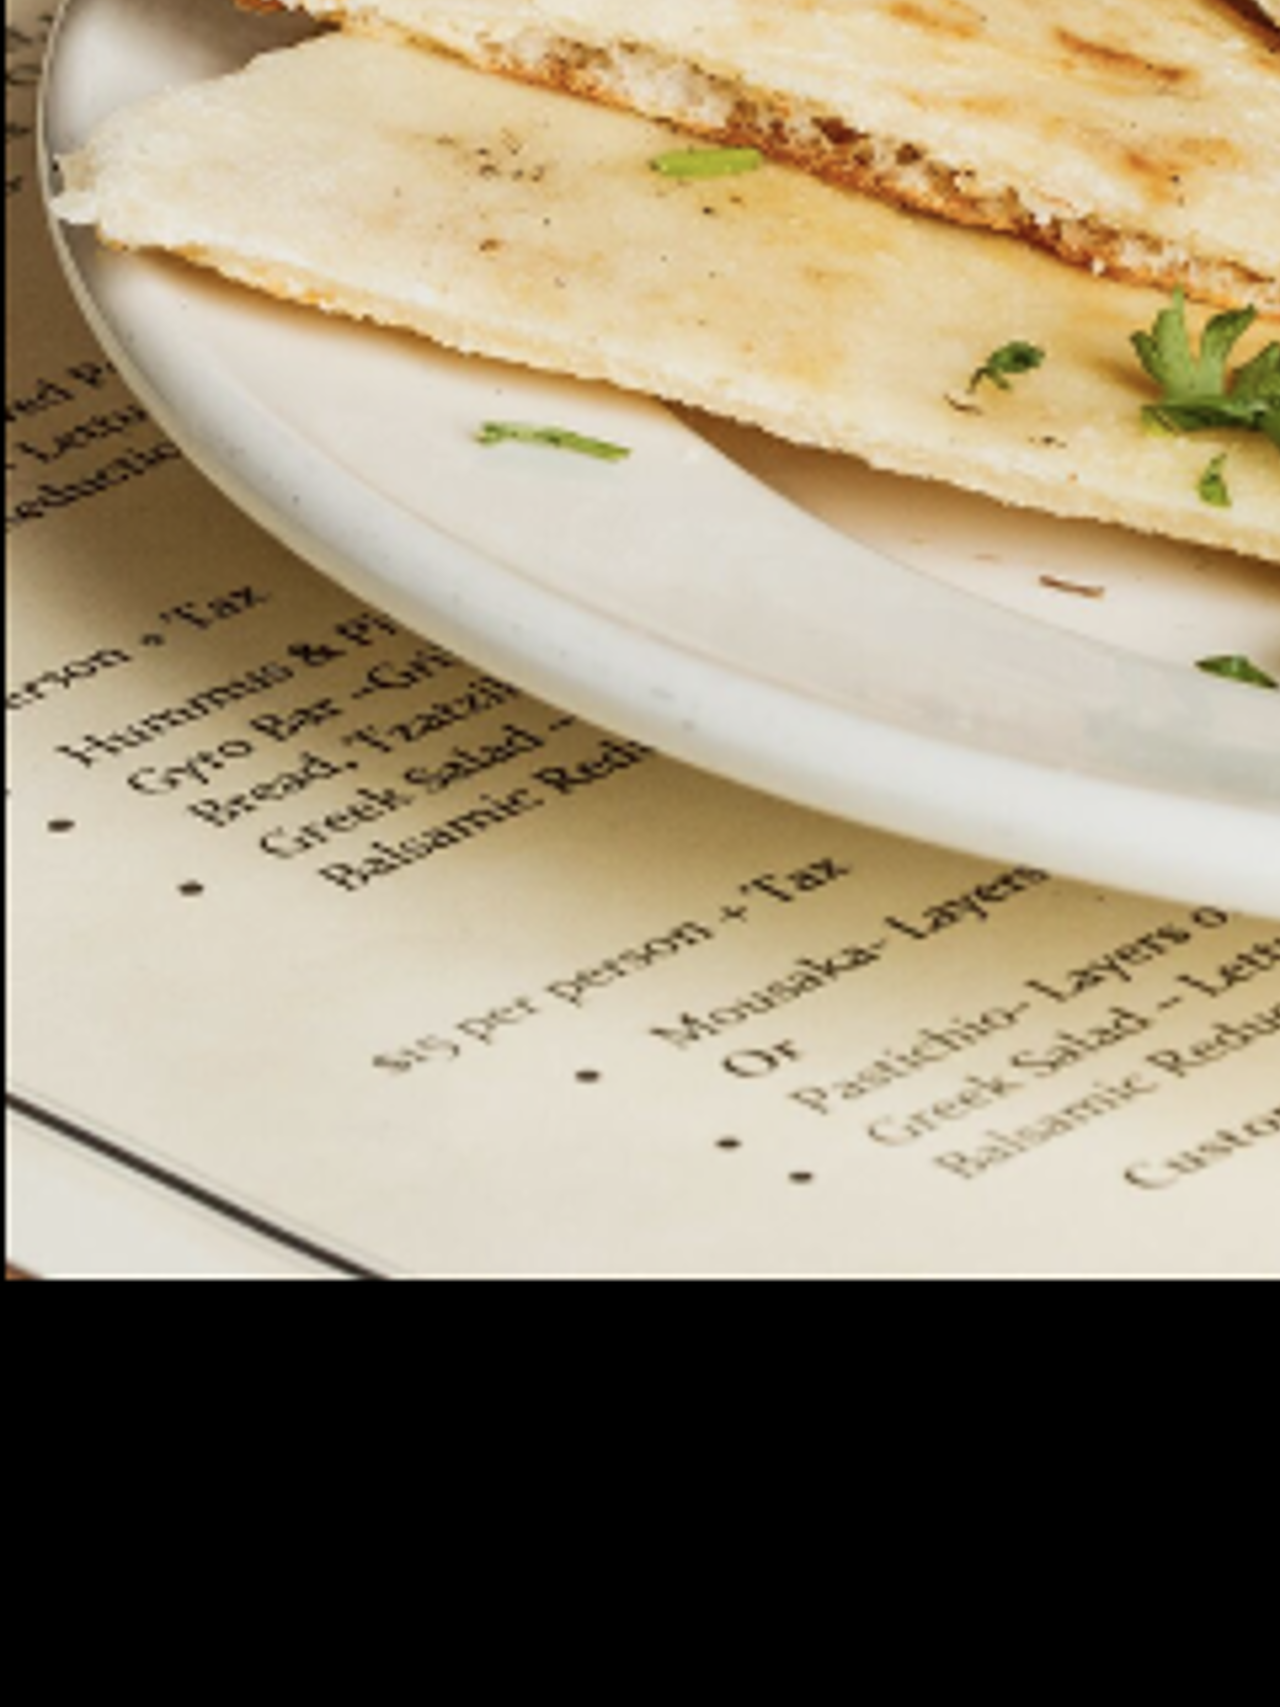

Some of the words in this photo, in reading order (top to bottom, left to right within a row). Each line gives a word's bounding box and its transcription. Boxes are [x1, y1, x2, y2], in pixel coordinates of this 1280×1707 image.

[159, 586, 270, 629] Tax
[54, 659, 298, 769] Hummus
[127, 737, 253, 797] Gyro
[249, 697, 345, 744] Bar
[187, 751, 359, 829] Bread,
[259, 788, 413, 860] Greek
[404, 723, 545, 793] Salad
[318, 791, 546, 892] Balsamic
[455, 996, 541, 1046] per
[545, 919, 715, 1010] person
[737, 857, 852, 904] Tax
[884, 863, 1052, 942] Layers
[1026, 920, 1192, 1002] Layers
[720, 1037, 805, 1080] Or
[866, 1074, 1025, 1148] Greek
[1008, 1005, 1151, 1079] Salad
[932, 1072, 1158, 1181] Balsamic
